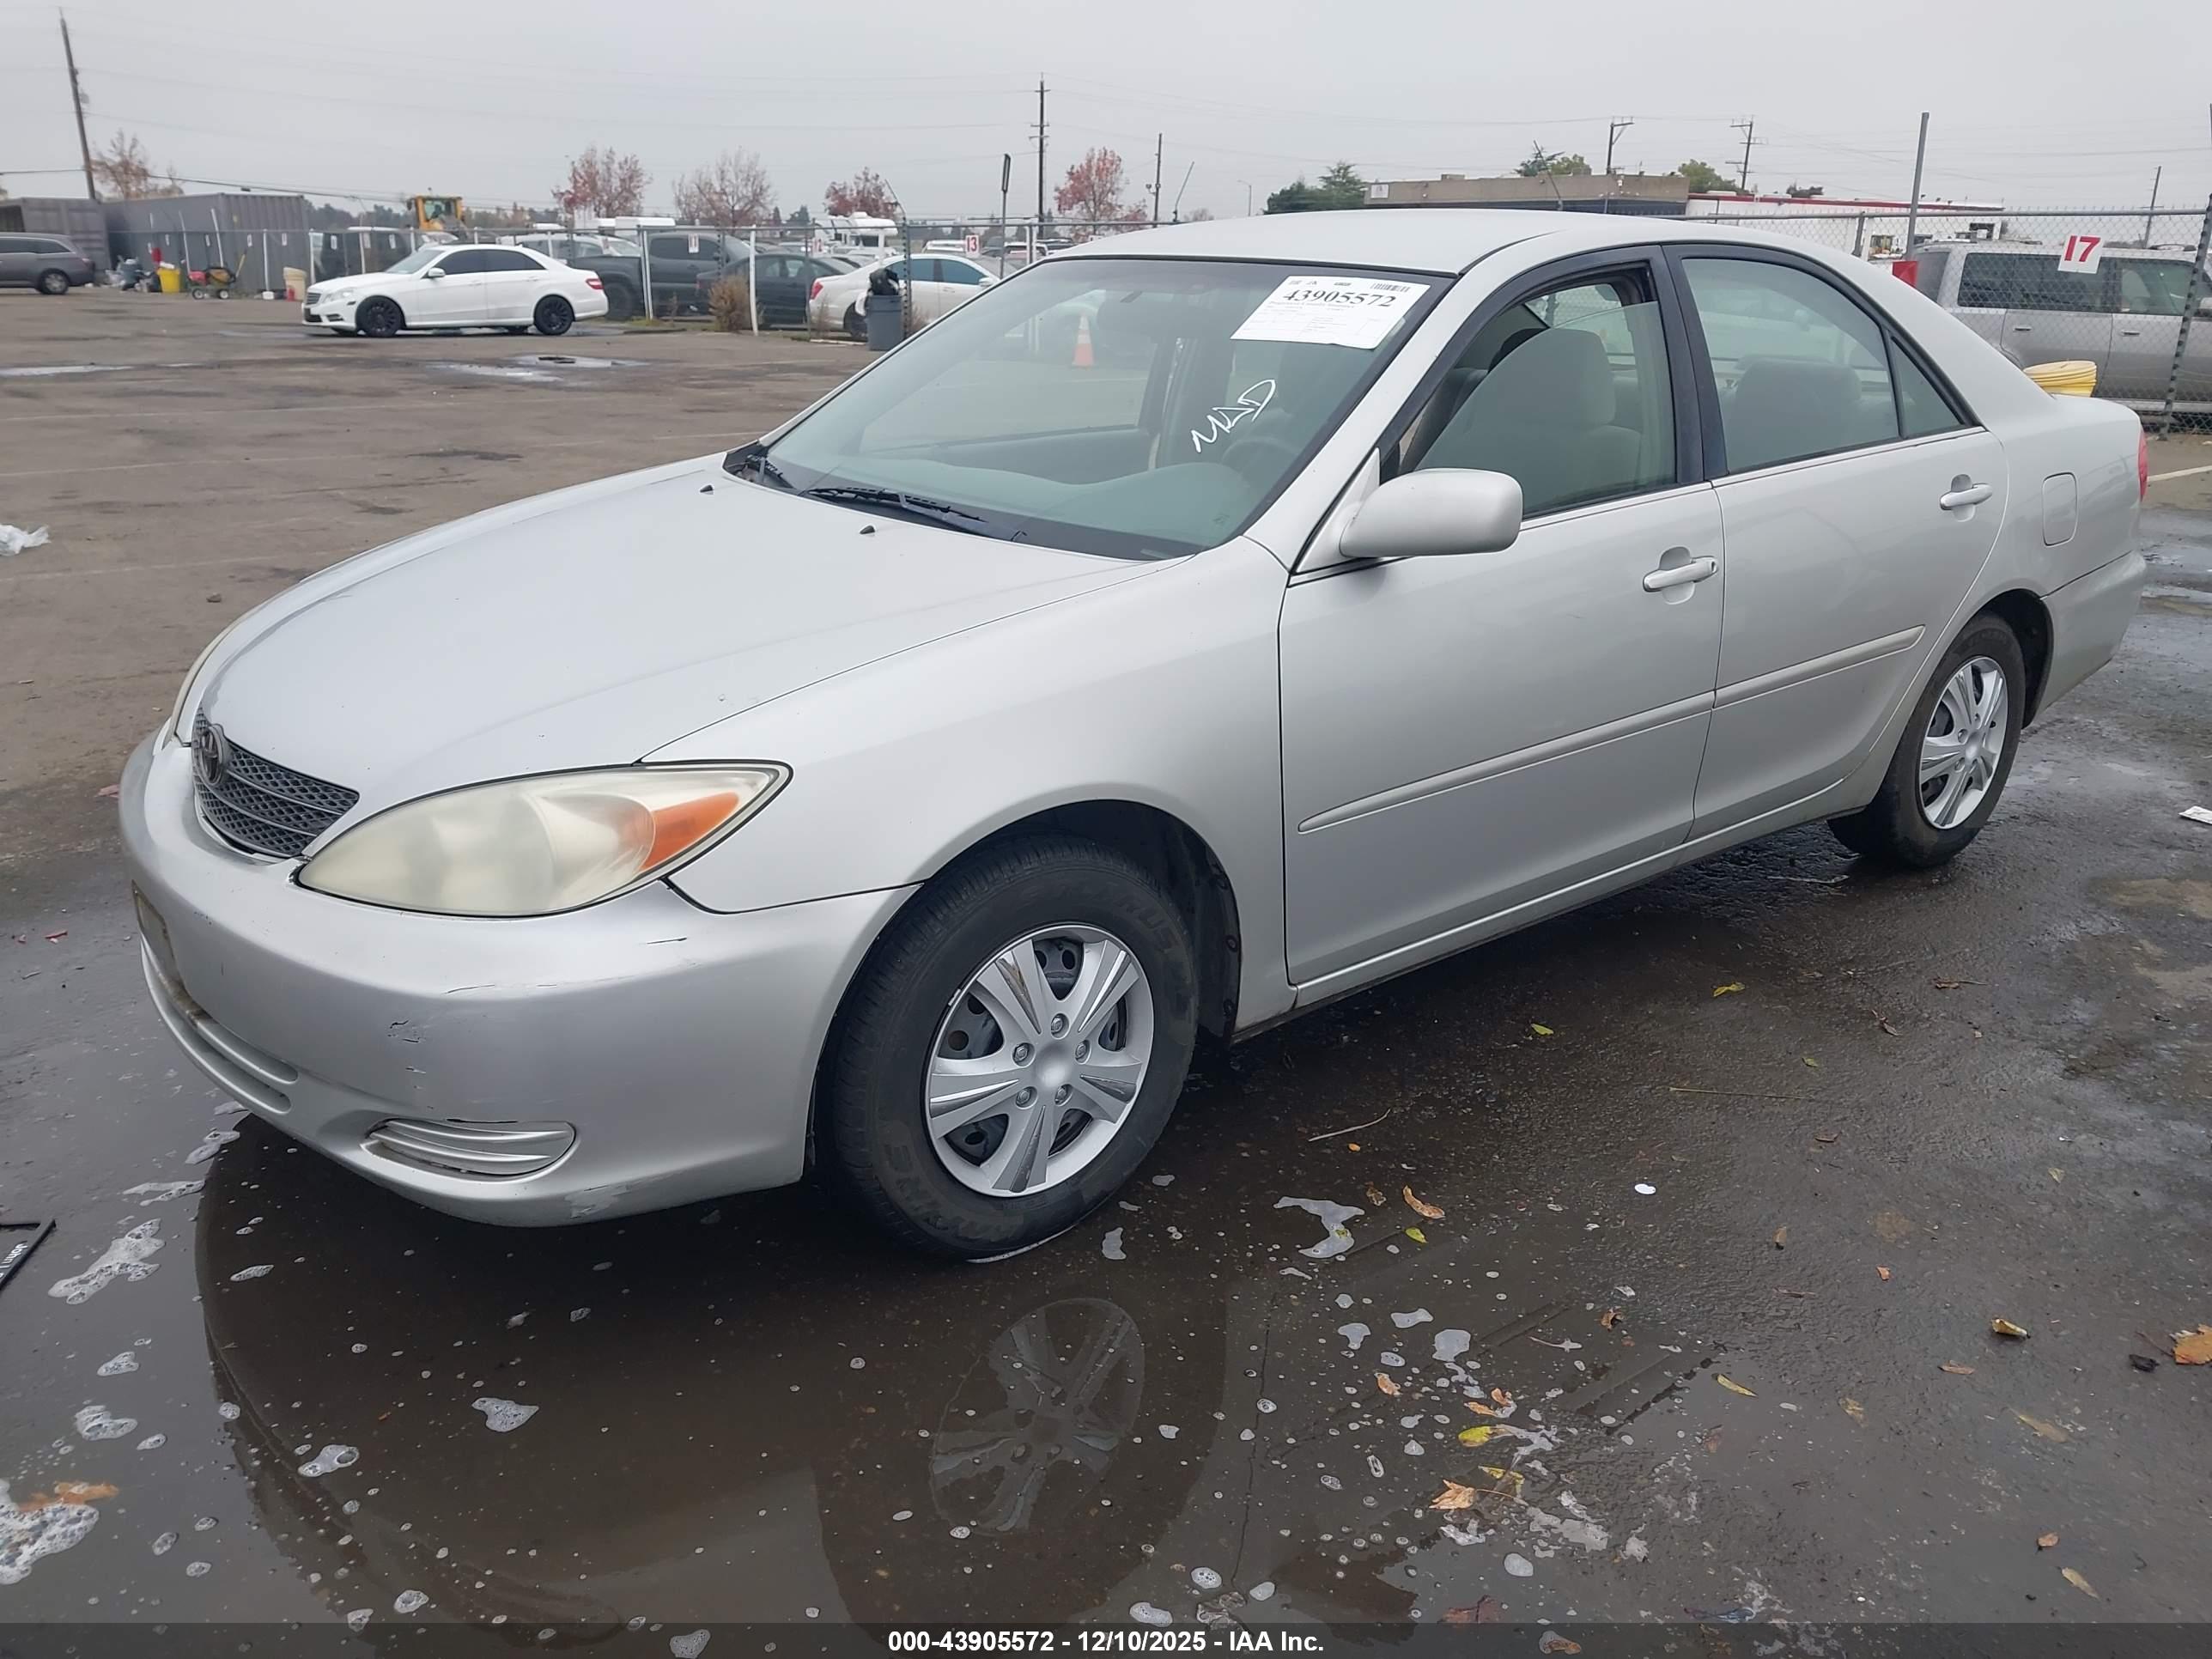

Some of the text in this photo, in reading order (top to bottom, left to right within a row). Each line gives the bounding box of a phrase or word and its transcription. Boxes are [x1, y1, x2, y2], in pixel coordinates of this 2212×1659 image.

[967, 236, 977, 252] 13
[2064, 235, 2101, 262] 17
[1283, 289, 1396, 307] 43905572
